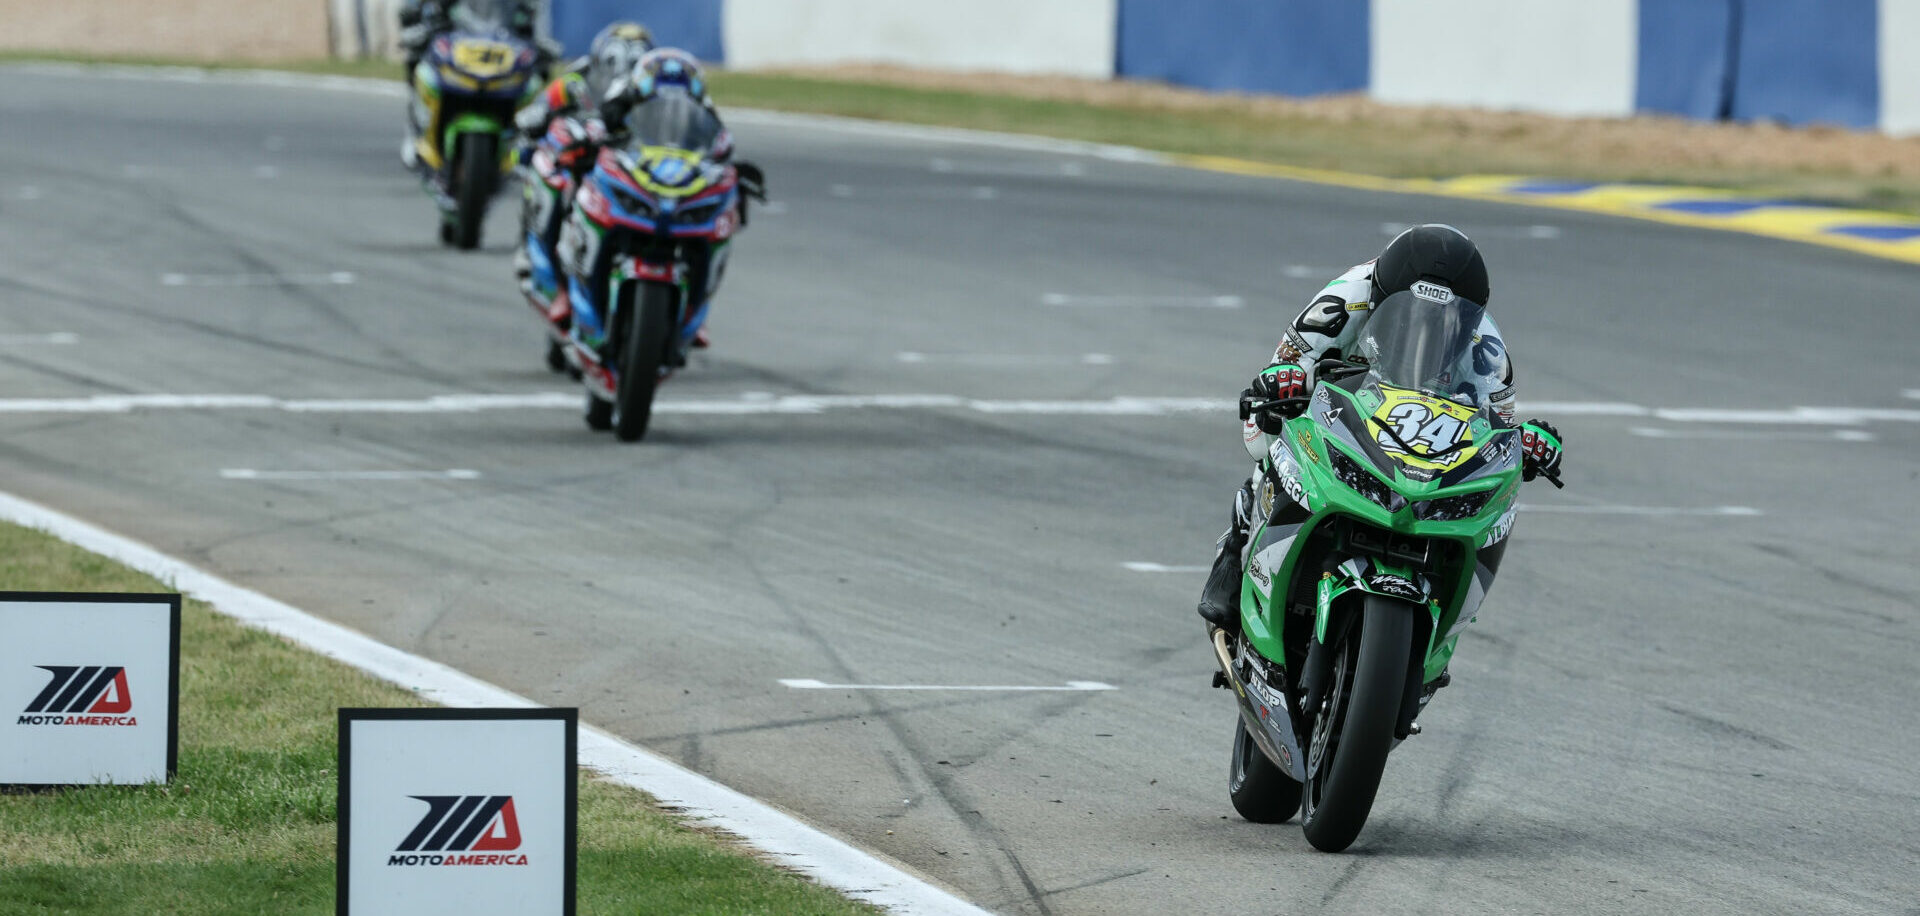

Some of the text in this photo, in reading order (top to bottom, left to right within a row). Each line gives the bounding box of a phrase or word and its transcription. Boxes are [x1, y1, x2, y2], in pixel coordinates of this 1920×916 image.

[1417, 284, 1450, 301] SHOEI
[1378, 402, 1467, 455] 34
[16, 715, 137, 726] MOTOAMERICA
[387, 854, 528, 866] MOTOAMERICA
